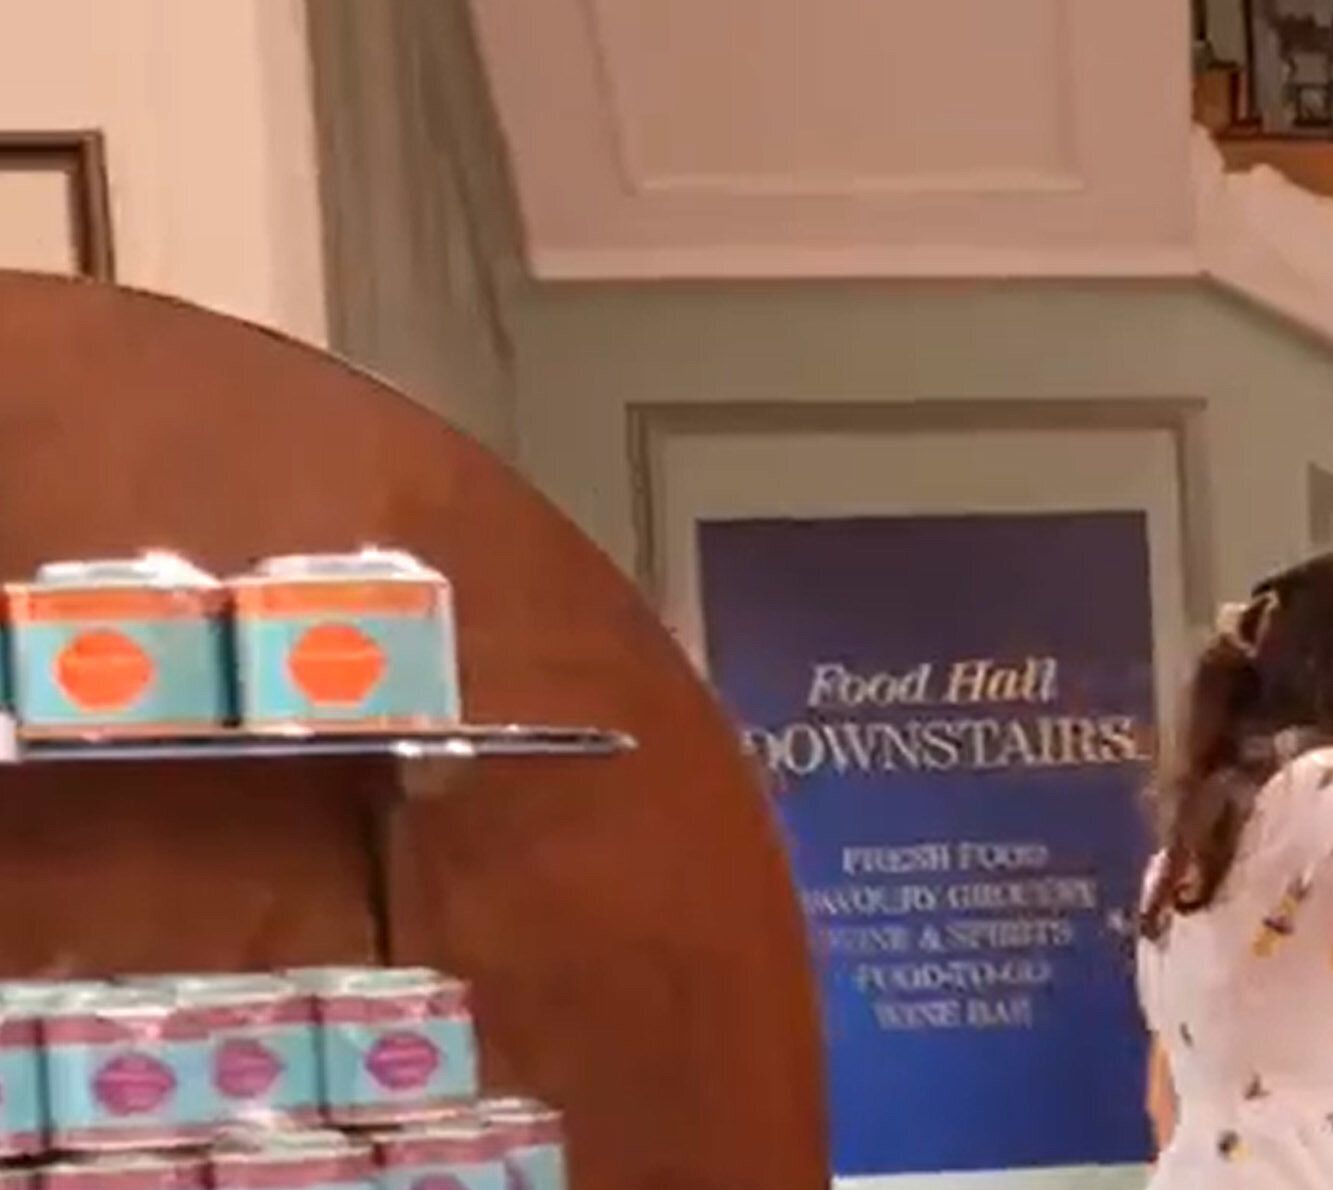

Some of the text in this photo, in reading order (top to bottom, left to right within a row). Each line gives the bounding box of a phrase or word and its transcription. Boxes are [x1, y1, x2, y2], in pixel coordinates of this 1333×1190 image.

[808, 656, 1057, 706] Food Hall
[841, 843, 1049, 874] FRESH FOOD
